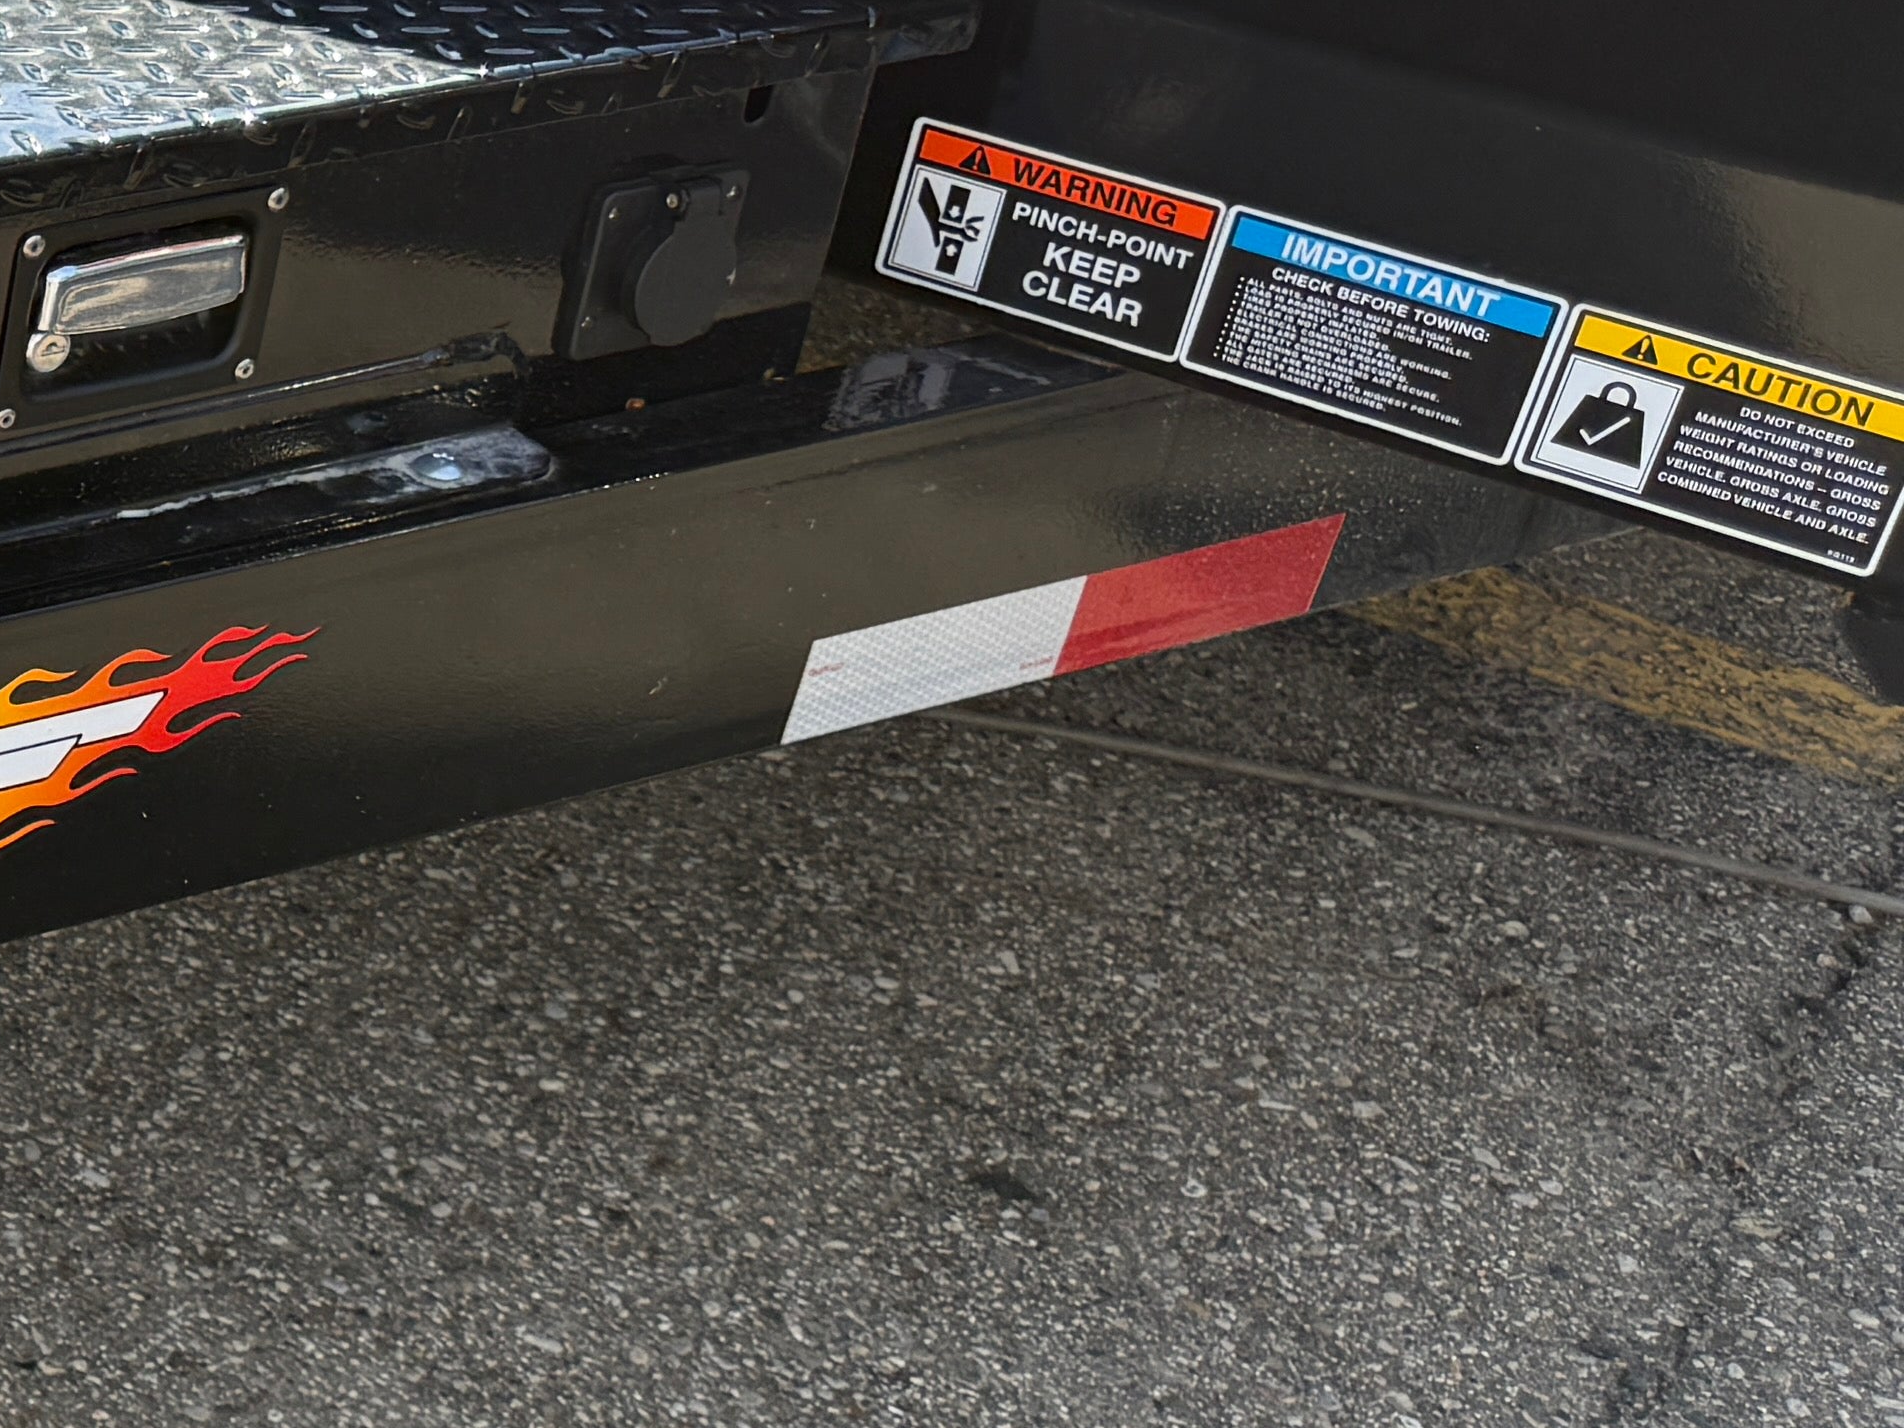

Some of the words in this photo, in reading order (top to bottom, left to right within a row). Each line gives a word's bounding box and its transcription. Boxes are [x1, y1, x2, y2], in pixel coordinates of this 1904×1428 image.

[1013, 157, 1178, 227] WARNING
[1012, 201, 1194, 269] PINCH-POINT
[1042, 242, 1141, 289] KEEP
[1022, 270, 1143, 327] CLEAR
[1269, 265, 1336, 296] CHECK
[1335, 285, 1410, 318] BEFORE
[1410, 307, 1491, 343] TOWING:
[1281, 232, 1502, 318] IMPORTANT
[1686, 352, 1875, 426] CAUTION
[1677, 424, 1735, 450] WEIGHT
[1735, 441, 1798, 468] RATINGS
[1799, 459, 1823, 475] OR
[1823, 467, 1889, 496] LOADING
[1694, 410, 1824, 457] MANUFACTURER'S
[1825, 449, 1887, 476] VEHICLE
[1739, 406, 1762, 421] DO
[1763, 413, 1795, 431] NOT
[1795, 423, 1855, 448] EXCEED
[1656, 470, 1732, 502] COMBINED
[1731, 492, 1794, 521] VEHICLE
[1793, 512, 1827, 531] AND
[1827, 522, 1870, 544] AXLE.
[1672, 440, 1815, 491] RECOMMENDATIONS
[1829, 487, 1882, 511] GROSS
[1728, 474, 1780, 499] GROSS
[1825, 502, 1877, 527] GROSS
